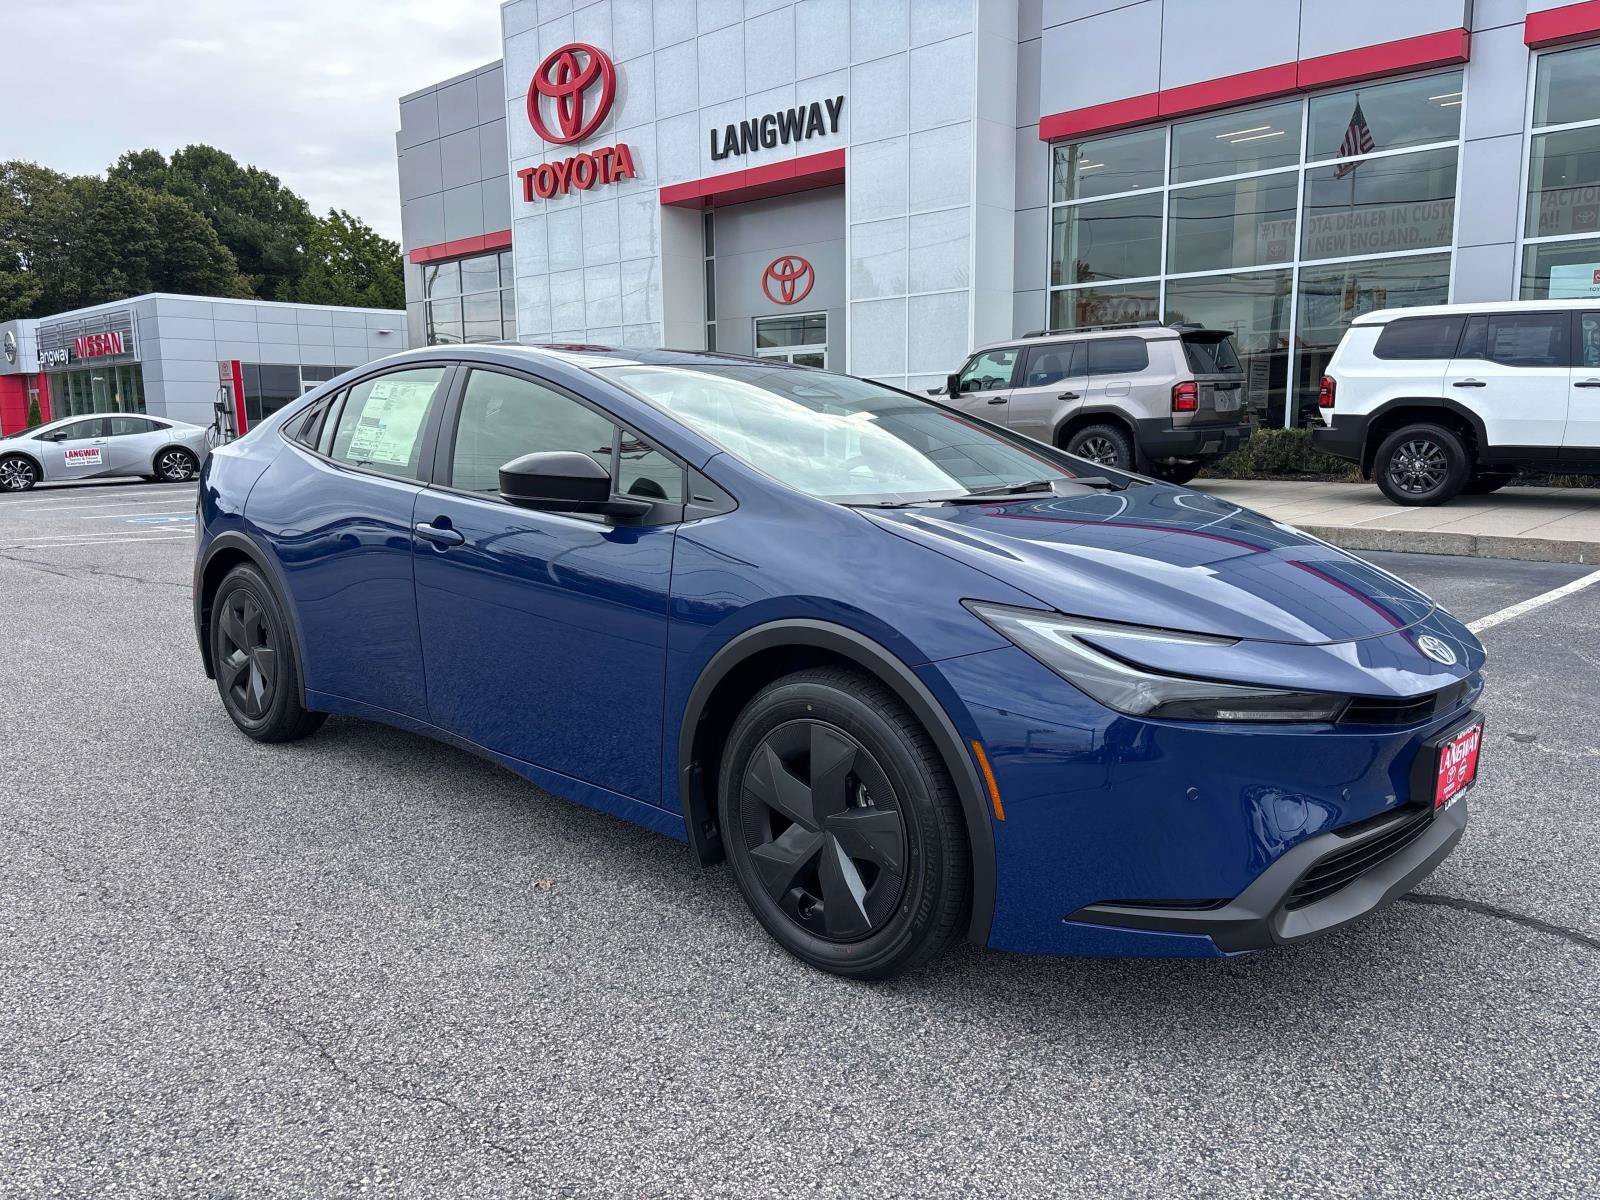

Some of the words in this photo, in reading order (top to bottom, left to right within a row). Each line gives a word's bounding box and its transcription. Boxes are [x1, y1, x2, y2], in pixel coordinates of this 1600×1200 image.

[710, 95, 844, 161] LANGWAY
[517, 143, 637, 202] TOYOTA
[1336, 209, 1387, 231] DEALER
[1391, 207, 1408, 225] IN
[1315, 233, 1346, 254] NEW
[36, 348, 69, 366] Langway
[74, 331, 123, 358] NISSAN
[65, 449, 100, 458] LANGWAY
[1440, 731, 1480, 774] LANGWAY
